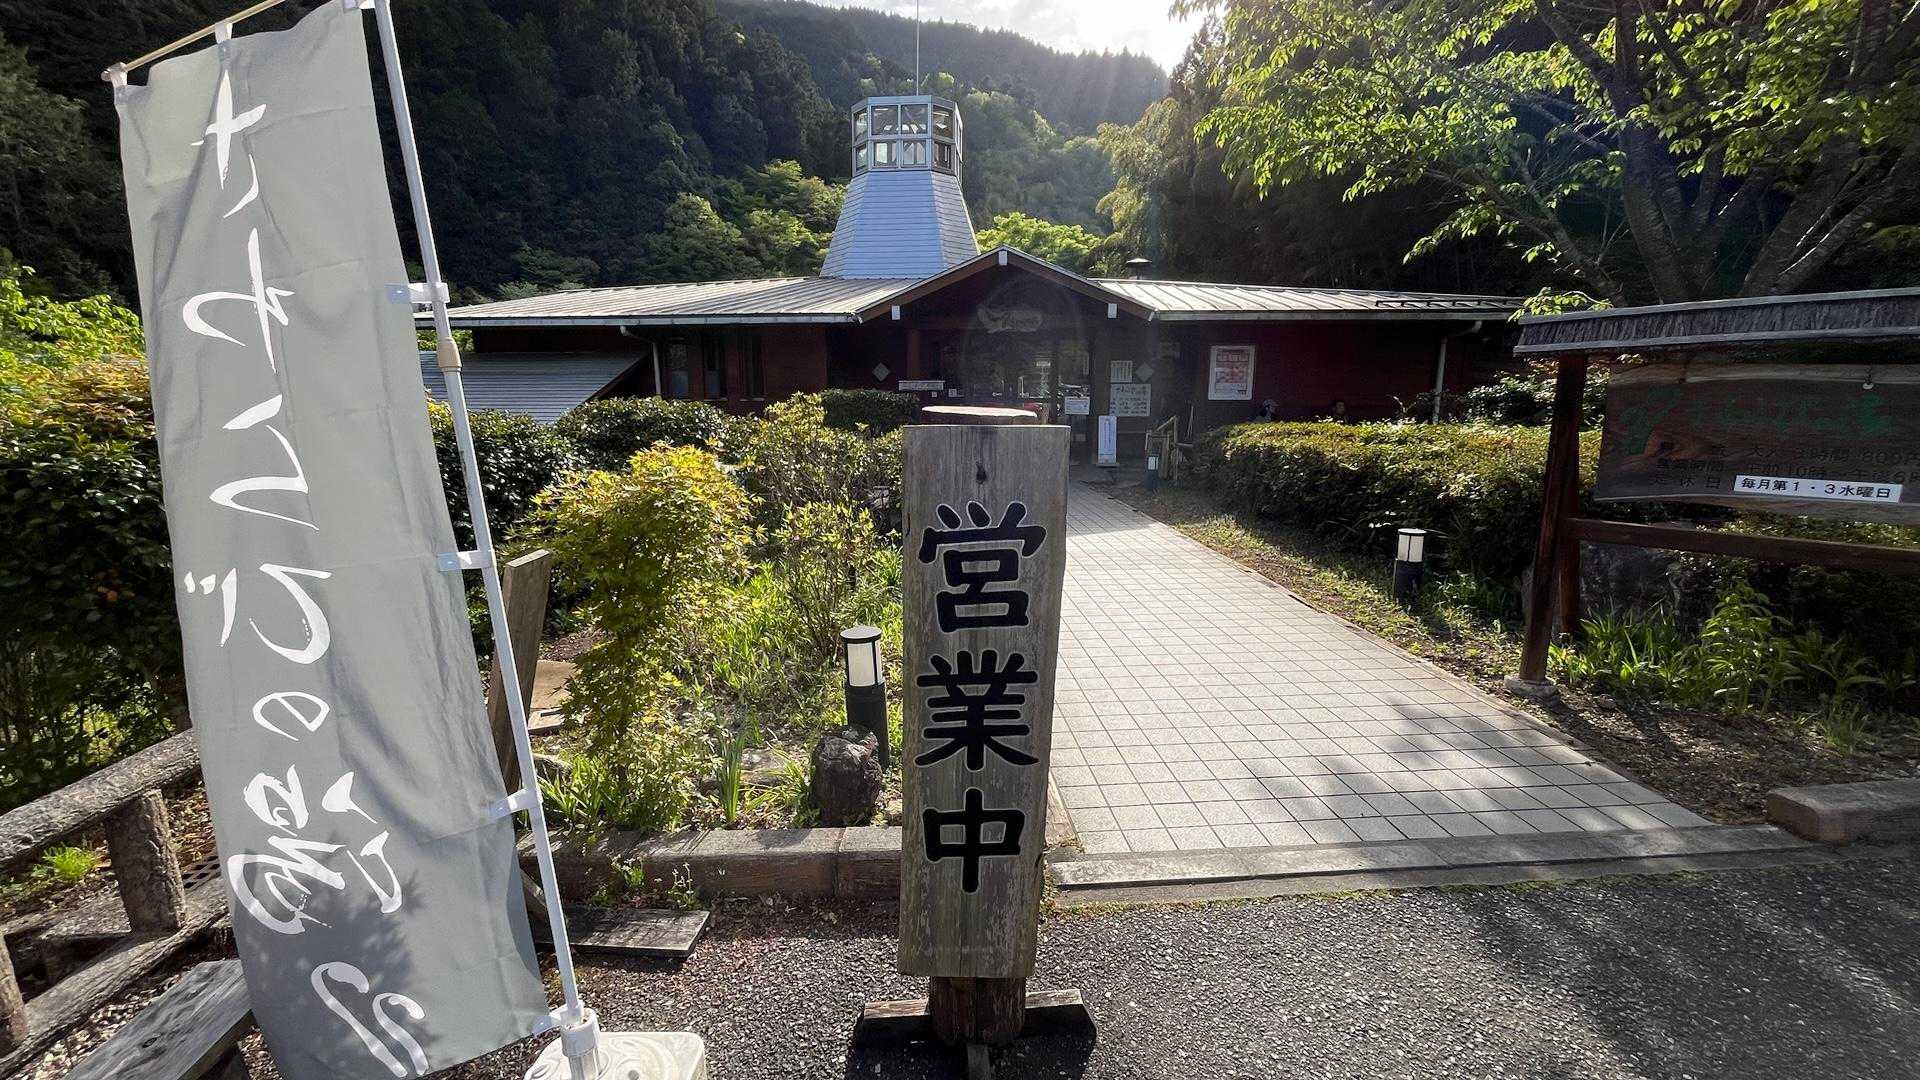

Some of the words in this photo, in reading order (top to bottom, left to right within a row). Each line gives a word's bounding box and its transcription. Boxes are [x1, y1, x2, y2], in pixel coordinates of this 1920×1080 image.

[1741, 477, 1892, 499] 毎月第1・3水曜日
[914, 500, 1047, 893] 営業中
